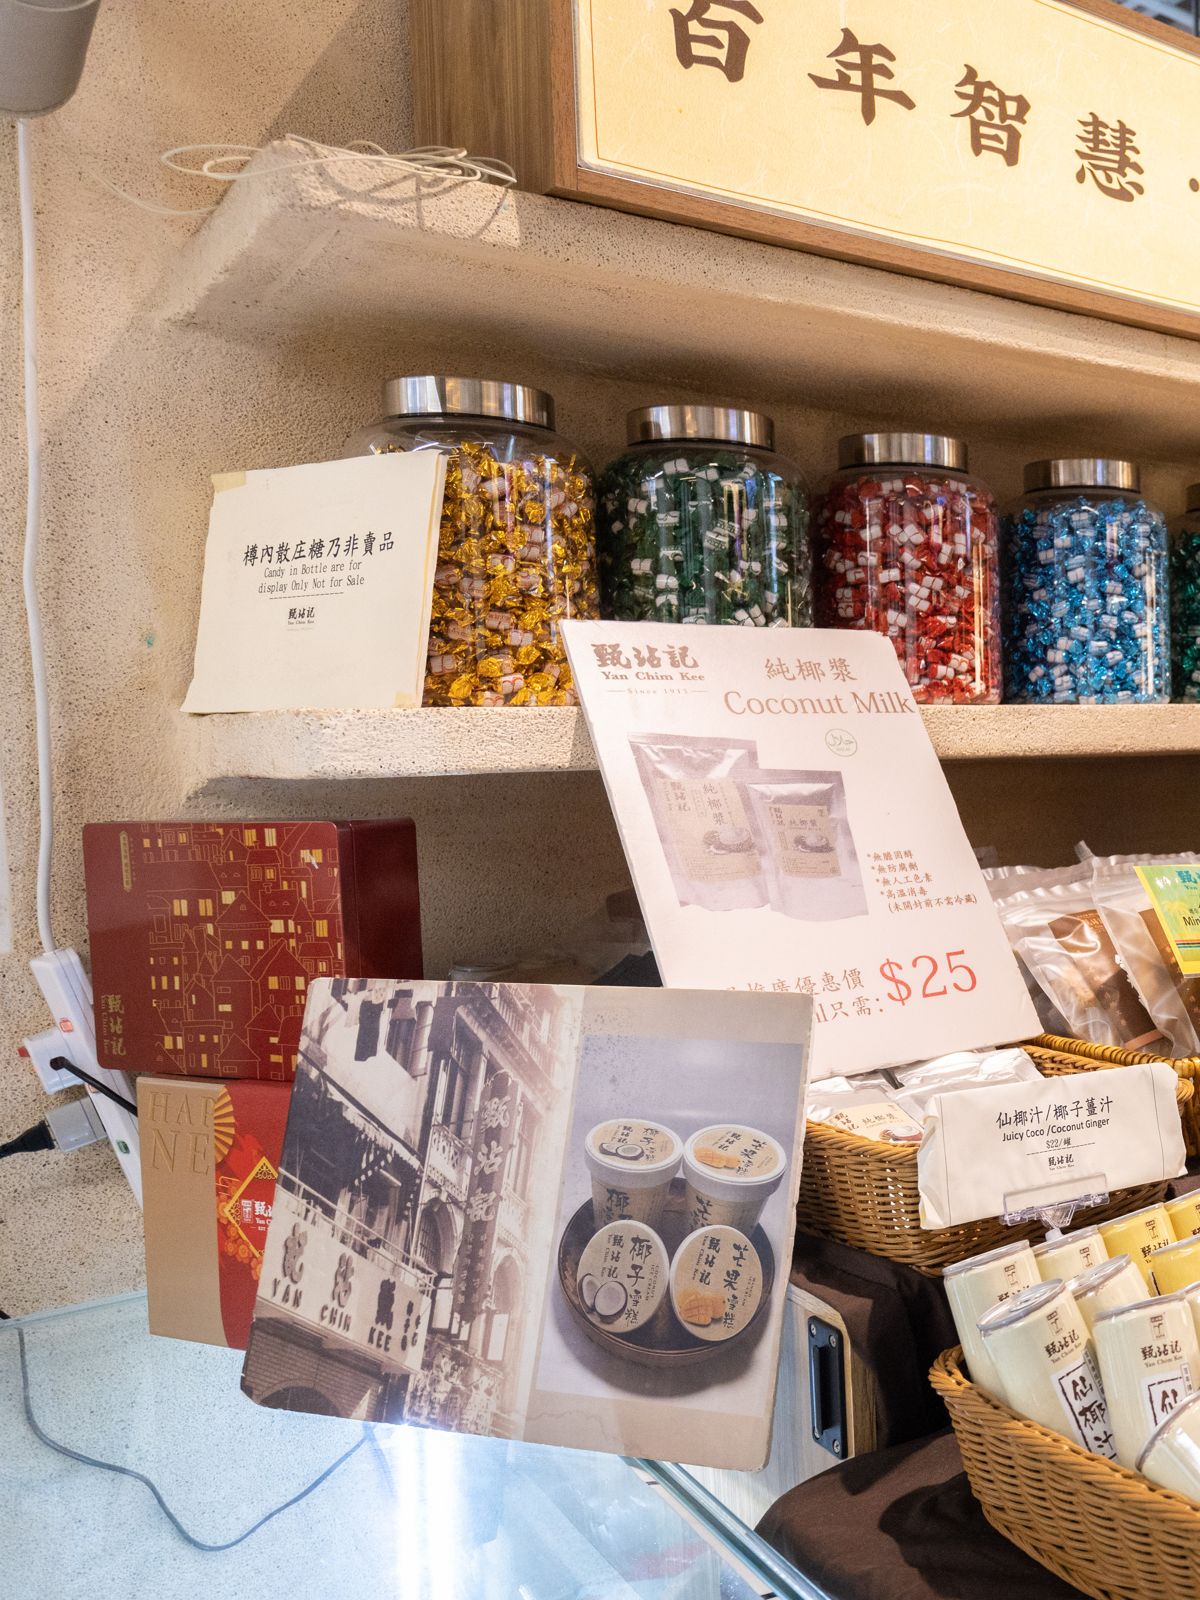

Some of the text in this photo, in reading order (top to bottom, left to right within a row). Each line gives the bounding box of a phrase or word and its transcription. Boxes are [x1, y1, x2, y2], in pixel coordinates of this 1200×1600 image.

[264, 560, 362, 579] Candy in Bottle are for
[258, 575, 365, 594] display Only Not for Sale
[601, 671, 705, 681] Yan Chim Kee
[723, 690, 917, 716] Coconut Milk
[879, 949, 978, 1006] $25
[1002, 1131, 1024, 1142] Juicy
[1025, 1128, 1045, 1138] Coco
[1085, 1118, 1110, 1129] Ginger
[271, 1276, 304, 1309] YAN
[319, 1303, 352, 1333] CHIN
[367, 1325, 393, 1353] KEE
